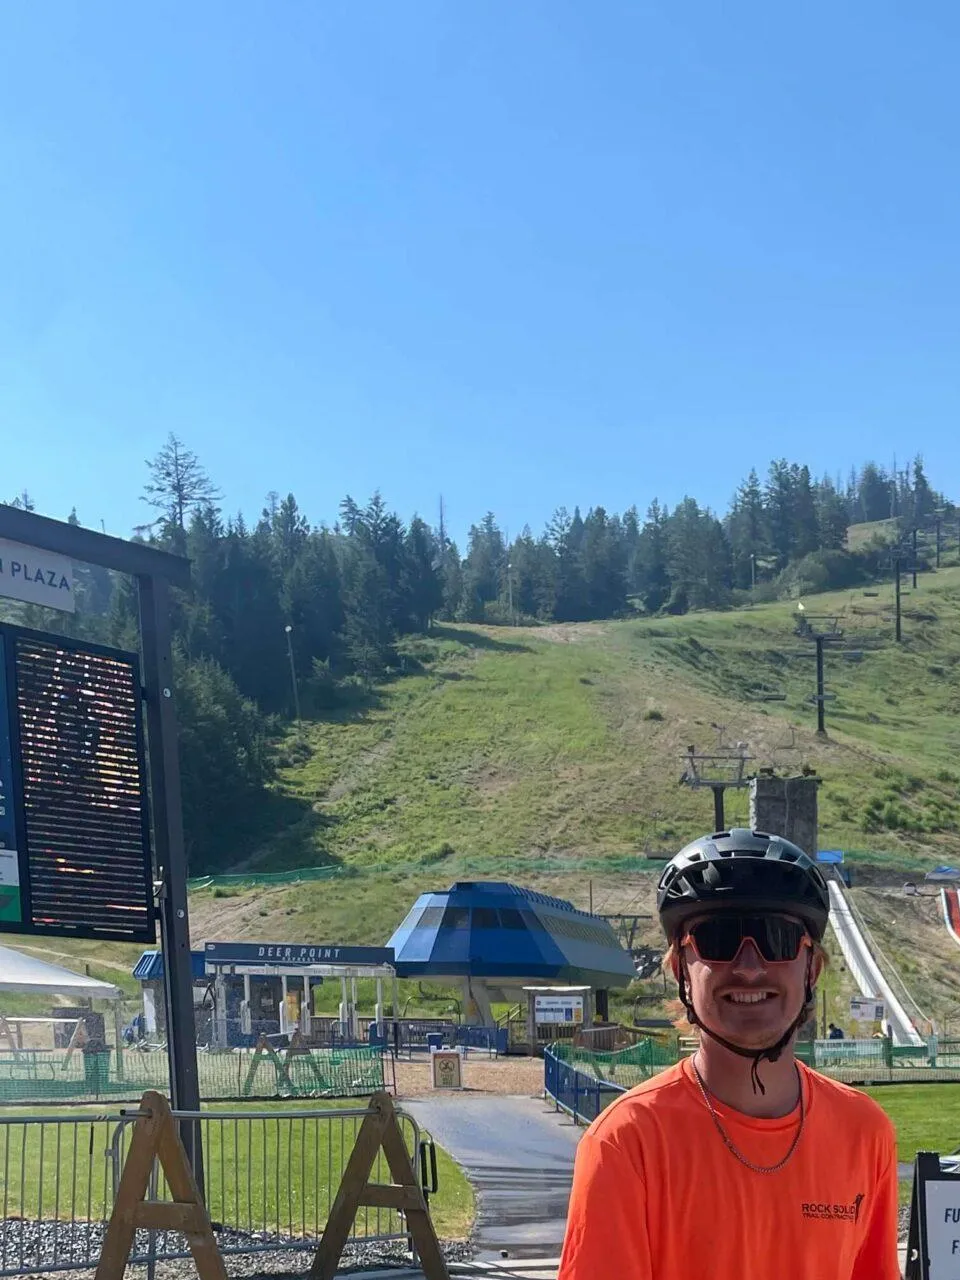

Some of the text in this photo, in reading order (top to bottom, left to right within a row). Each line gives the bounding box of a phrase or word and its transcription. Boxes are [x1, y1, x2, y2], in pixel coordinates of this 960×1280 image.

[11, 561, 70, 592] PLAZA
[258, 946, 341, 958] DEER POINT
[802, 1203, 856, 1215] ROCK SOLID
